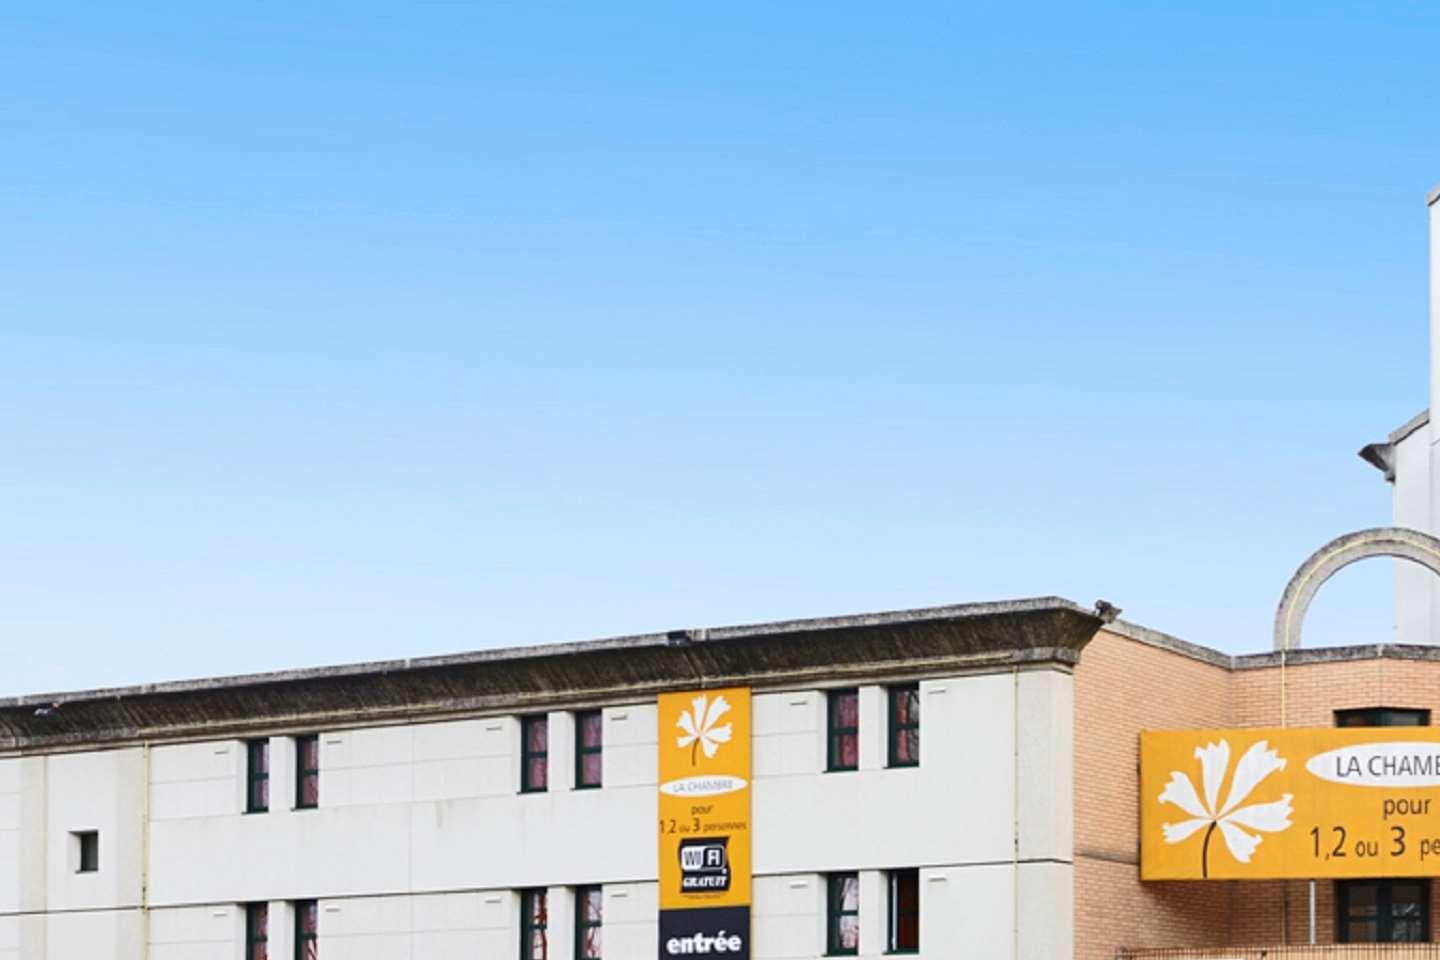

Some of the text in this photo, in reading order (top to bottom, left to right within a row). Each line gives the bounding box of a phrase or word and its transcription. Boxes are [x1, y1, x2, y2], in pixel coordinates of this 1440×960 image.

[1336, 756, 1362, 777] LA
[691, 805, 714, 816] pour
[1383, 797, 1432, 819] pour
[692, 818, 701, 832] 3
[1354, 840, 1379, 857] ou
[1389, 825, 1407, 857] 3
[666, 930, 742, 954] entrée
